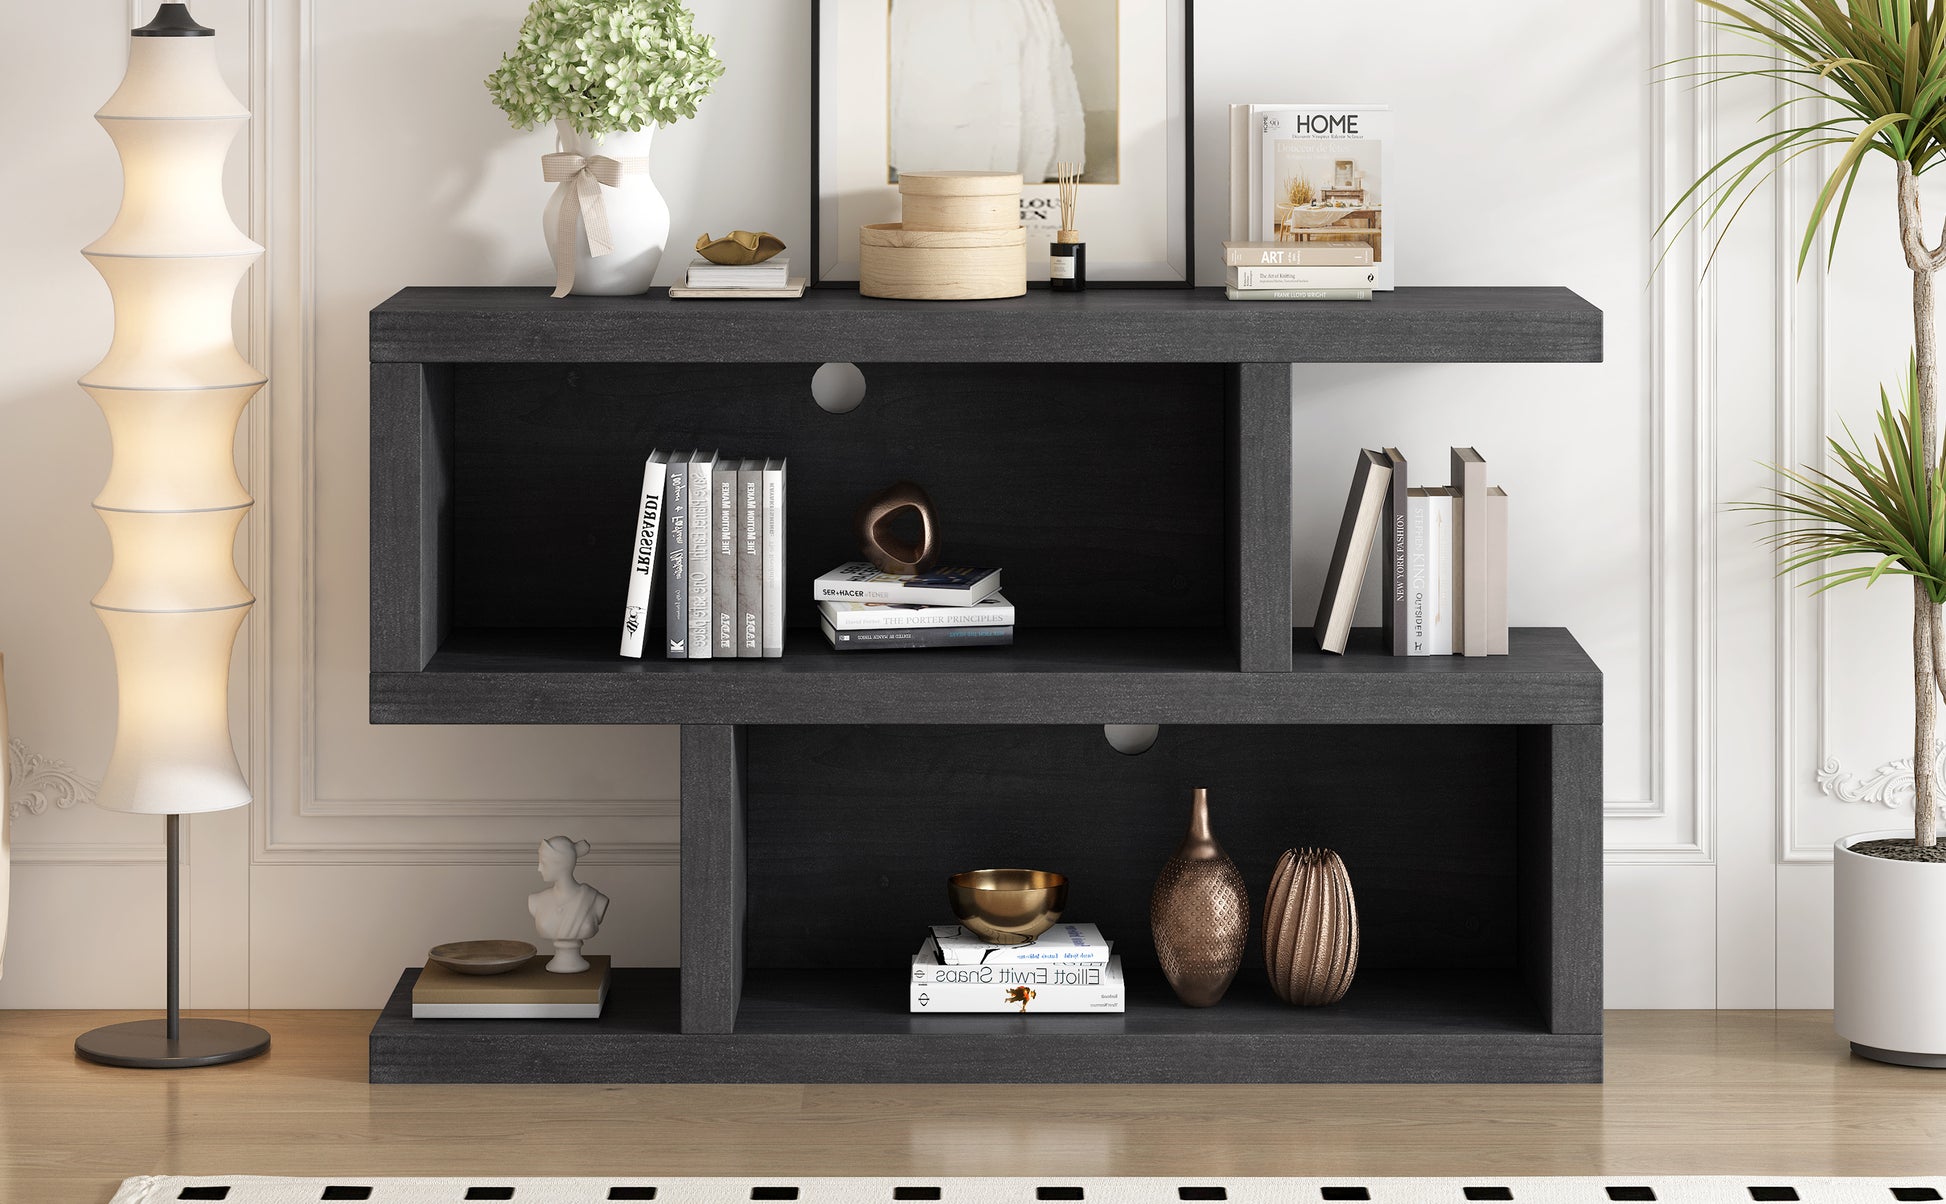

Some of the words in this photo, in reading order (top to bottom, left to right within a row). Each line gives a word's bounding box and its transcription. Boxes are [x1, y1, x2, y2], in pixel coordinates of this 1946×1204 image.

[1297, 114, 1358, 134] HOME
[1261, 251, 1284, 264] ART
[1397, 514, 1405, 552] FASHION
[1414, 508, 1423, 551] STEPHEN
[1397, 553, 1405, 580] YORK
[1413, 553, 1425, 589] KING
[1397, 581, 1405, 601] NEW
[883, 617, 904, 625] THE
[906, 616, 944, 625] PORTER
[947, 614, 1004, 624] PRINCIPLES
[1415, 592, 1423, 637] OUTSIDER
